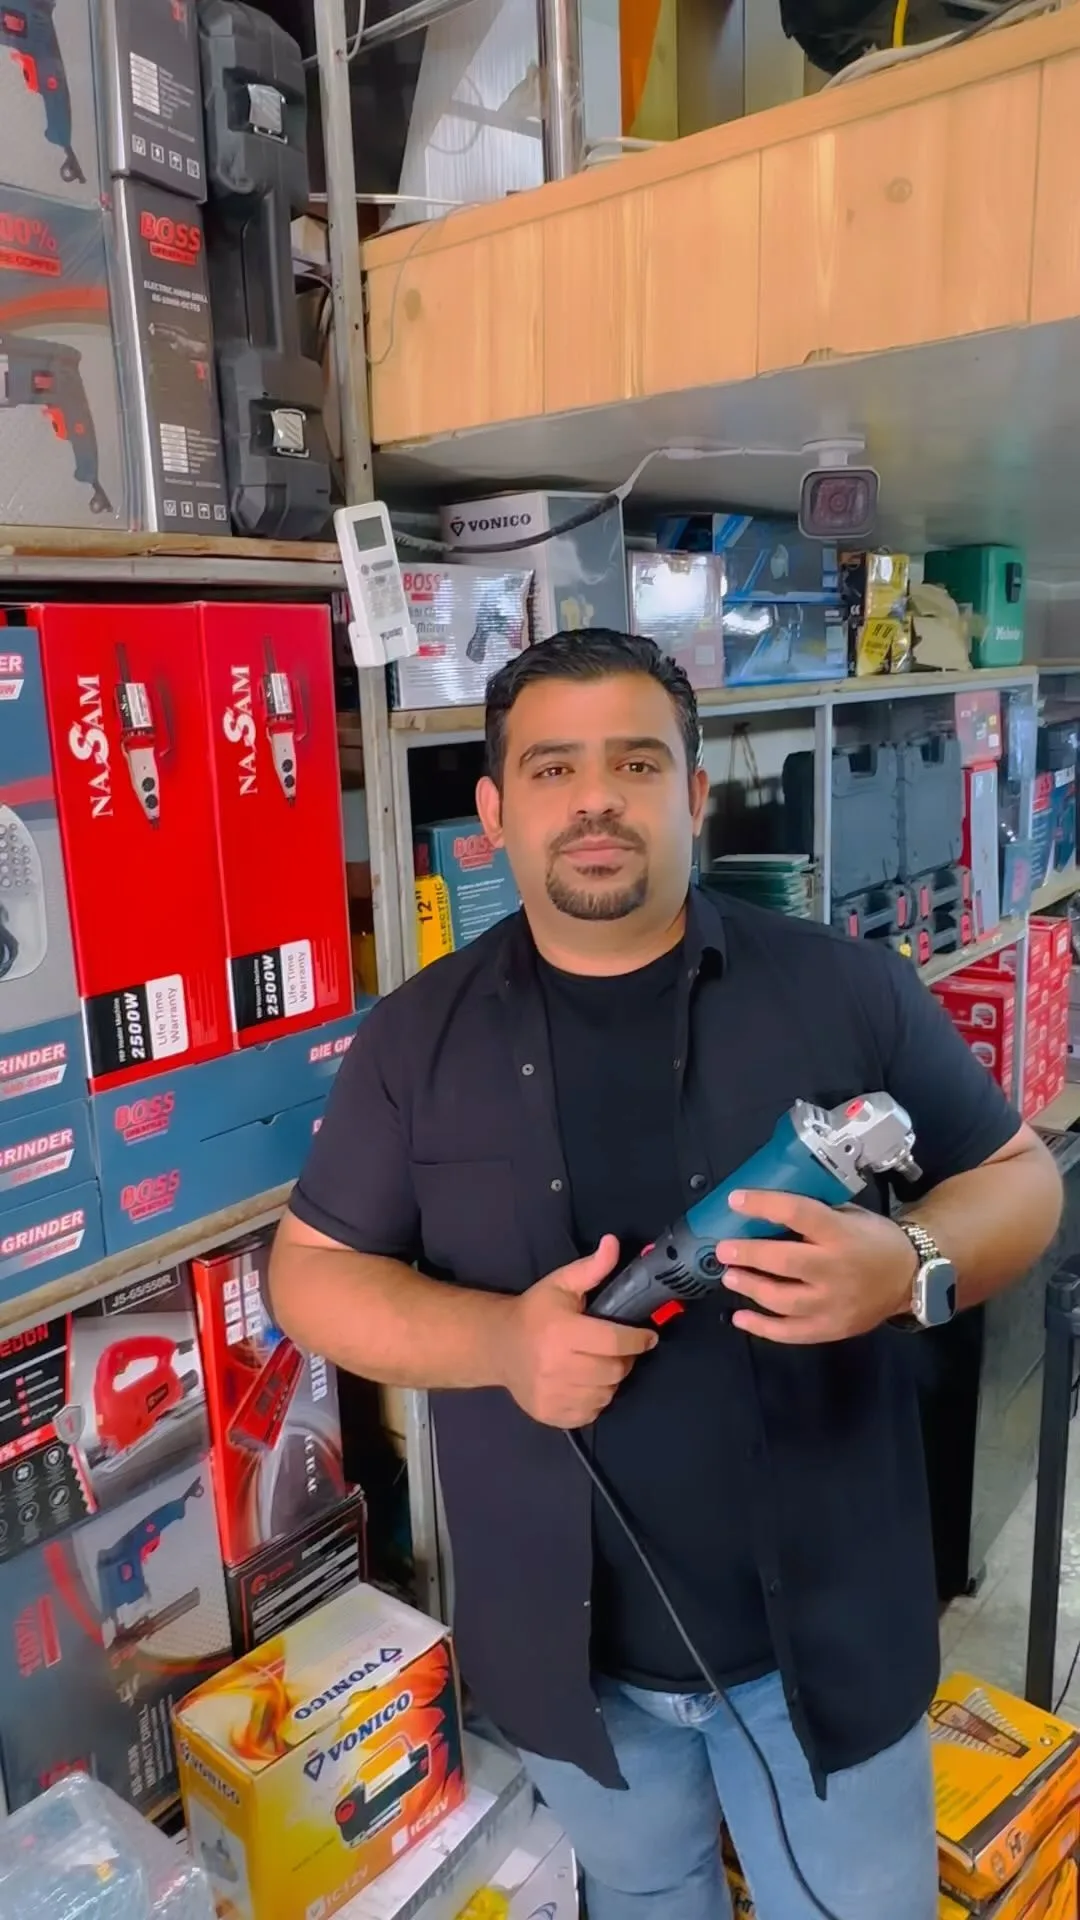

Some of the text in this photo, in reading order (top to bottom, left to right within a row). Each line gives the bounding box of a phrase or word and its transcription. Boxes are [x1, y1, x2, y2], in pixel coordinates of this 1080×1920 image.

[0, 212, 57, 252] 00%
[139, 211, 201, 253] BOSS
[468, 513, 532, 532] VONICO
[453, 834, 493, 859] BOS
[262, 954, 279, 1016] 2500W
[286, 954, 298, 1005] Life Time
[297, 951, 308, 1003] Warranty
[124, 991, 146, 1059] 2500W
[154, 991, 167, 1046] Life Time
[166, 987, 180, 1043] Warranty
[310, 1032, 356, 1062] DIE GR
[115, 1091, 175, 1130] BOSS
[120, 1169, 180, 1211] BOSS
[1, 1209, 84, 1254] GRINDER
[293, 1662, 380, 1720] VONICO
[138, 1703, 156, 1789] IMPACT DRILL
[327, 1692, 410, 1762] VONICO
[410, 1797, 449, 1836] IC24V
